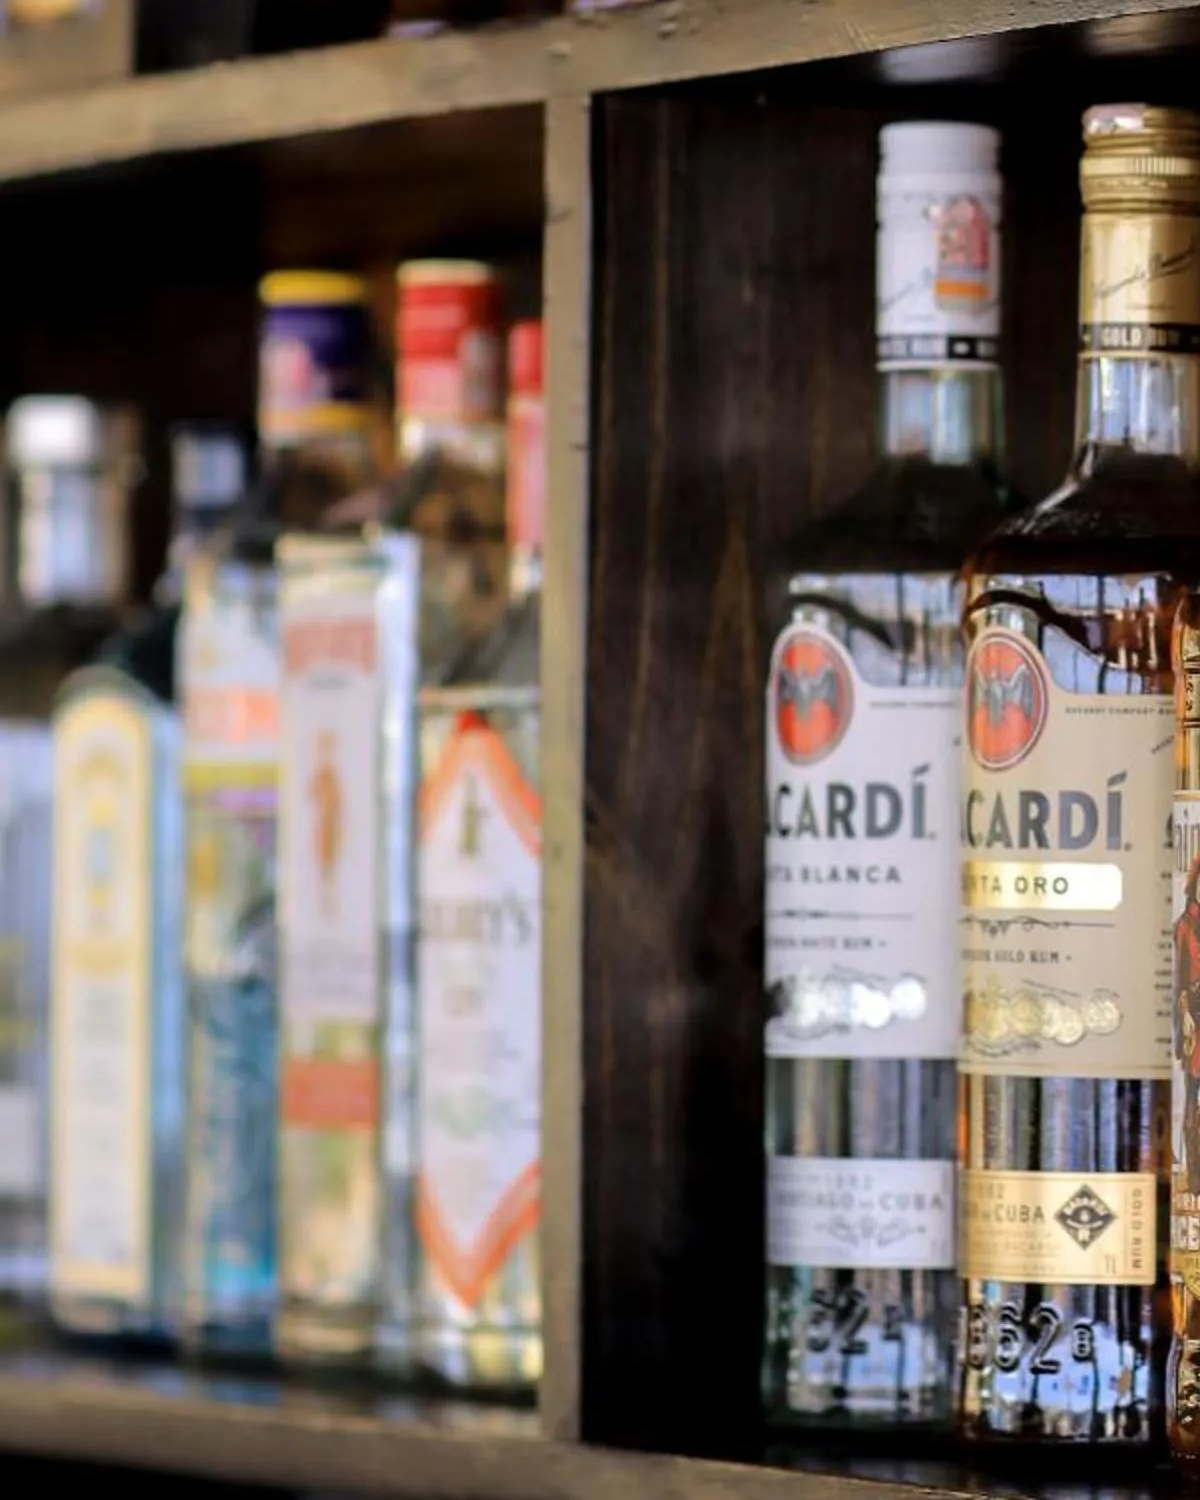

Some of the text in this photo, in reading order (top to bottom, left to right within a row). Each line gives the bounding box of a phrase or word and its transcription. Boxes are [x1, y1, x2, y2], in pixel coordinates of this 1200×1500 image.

[1101, 325, 1142, 348] GOLD
[765, 763, 932, 842] CARDÍ
[960, 770, 1127, 851] CARDÍ
[801, 864, 902, 885] BLANCA
[1014, 876, 1070, 896] ORO
[1030, 949, 1060, 965] RUM
[994, 1203, 1046, 1223] CUBA
[1131, 1188, 1144, 1270] GOLD RUM
